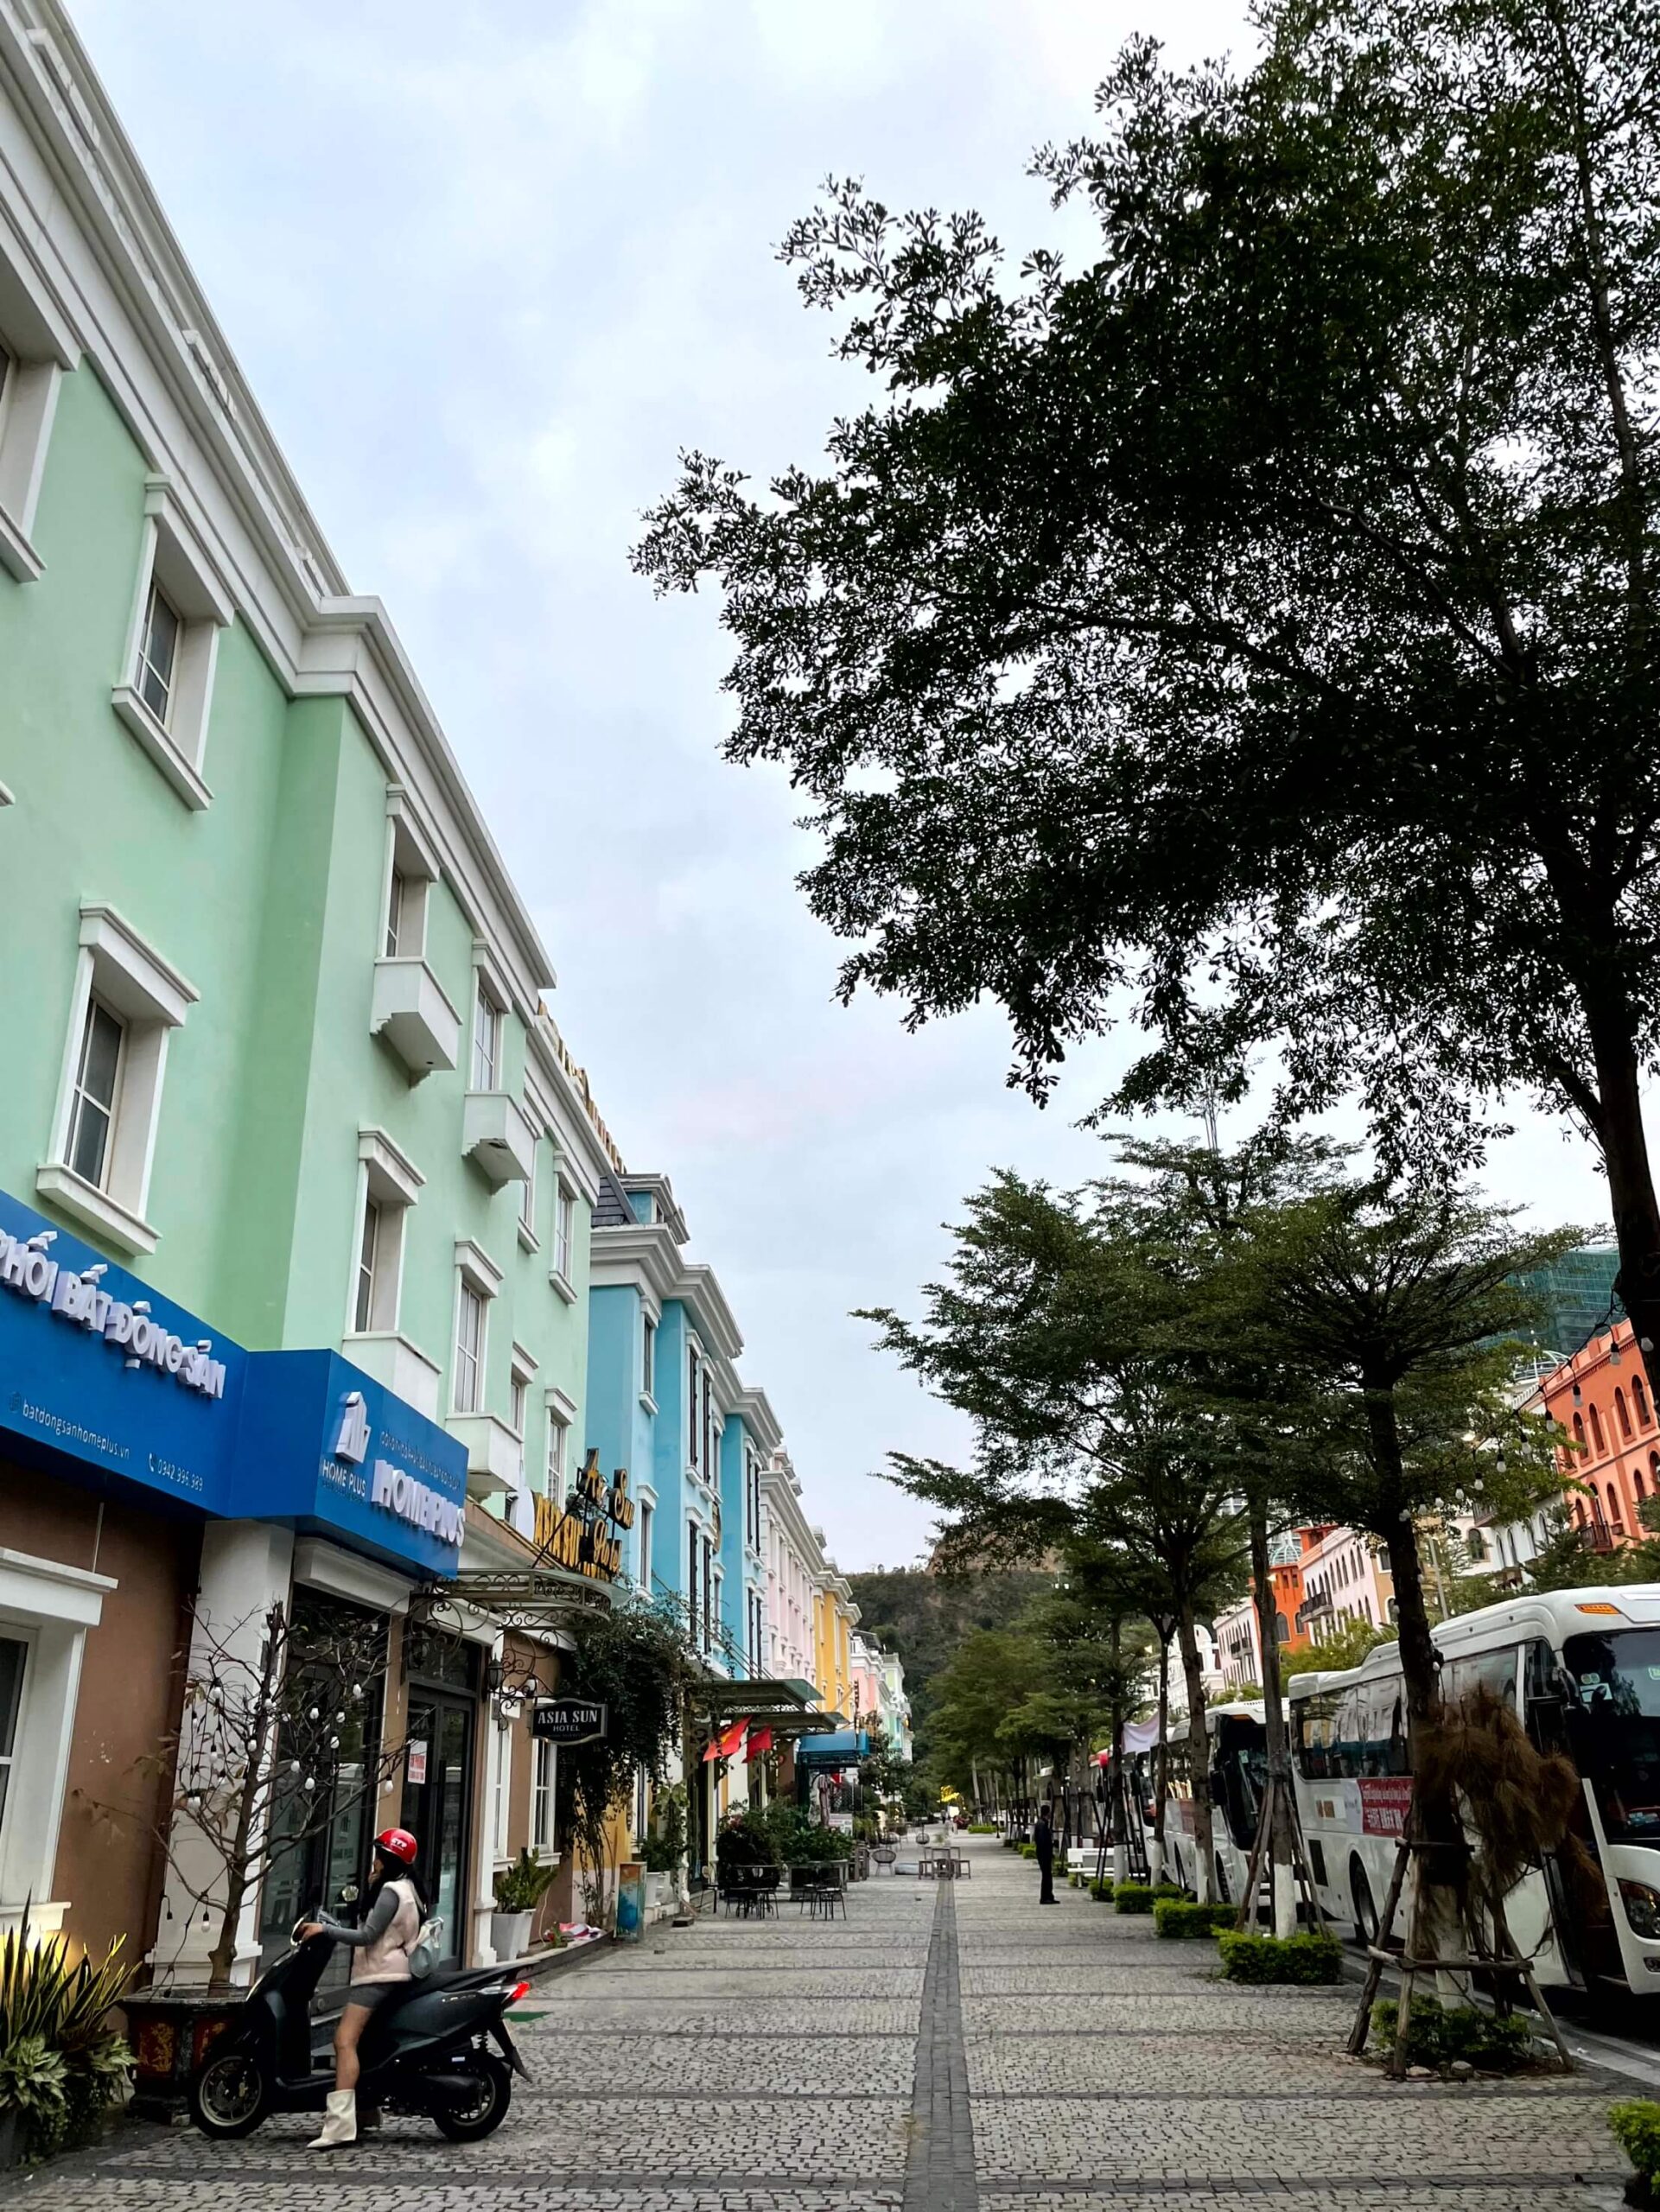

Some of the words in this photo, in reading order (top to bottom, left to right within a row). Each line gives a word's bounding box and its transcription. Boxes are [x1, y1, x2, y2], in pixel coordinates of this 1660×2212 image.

[54, 1264, 113, 1332] BẤT
[105, 1301, 183, 1373] ĐỘNG
[22, 1399, 130, 1459] batdongsanhomeplus.vn
[322, 1459, 347, 1487] HOME
[348, 1472, 366, 1497] PLUS
[537, 1711, 568, 1724] ASIA
[572, 1709, 598, 1723] SUN
